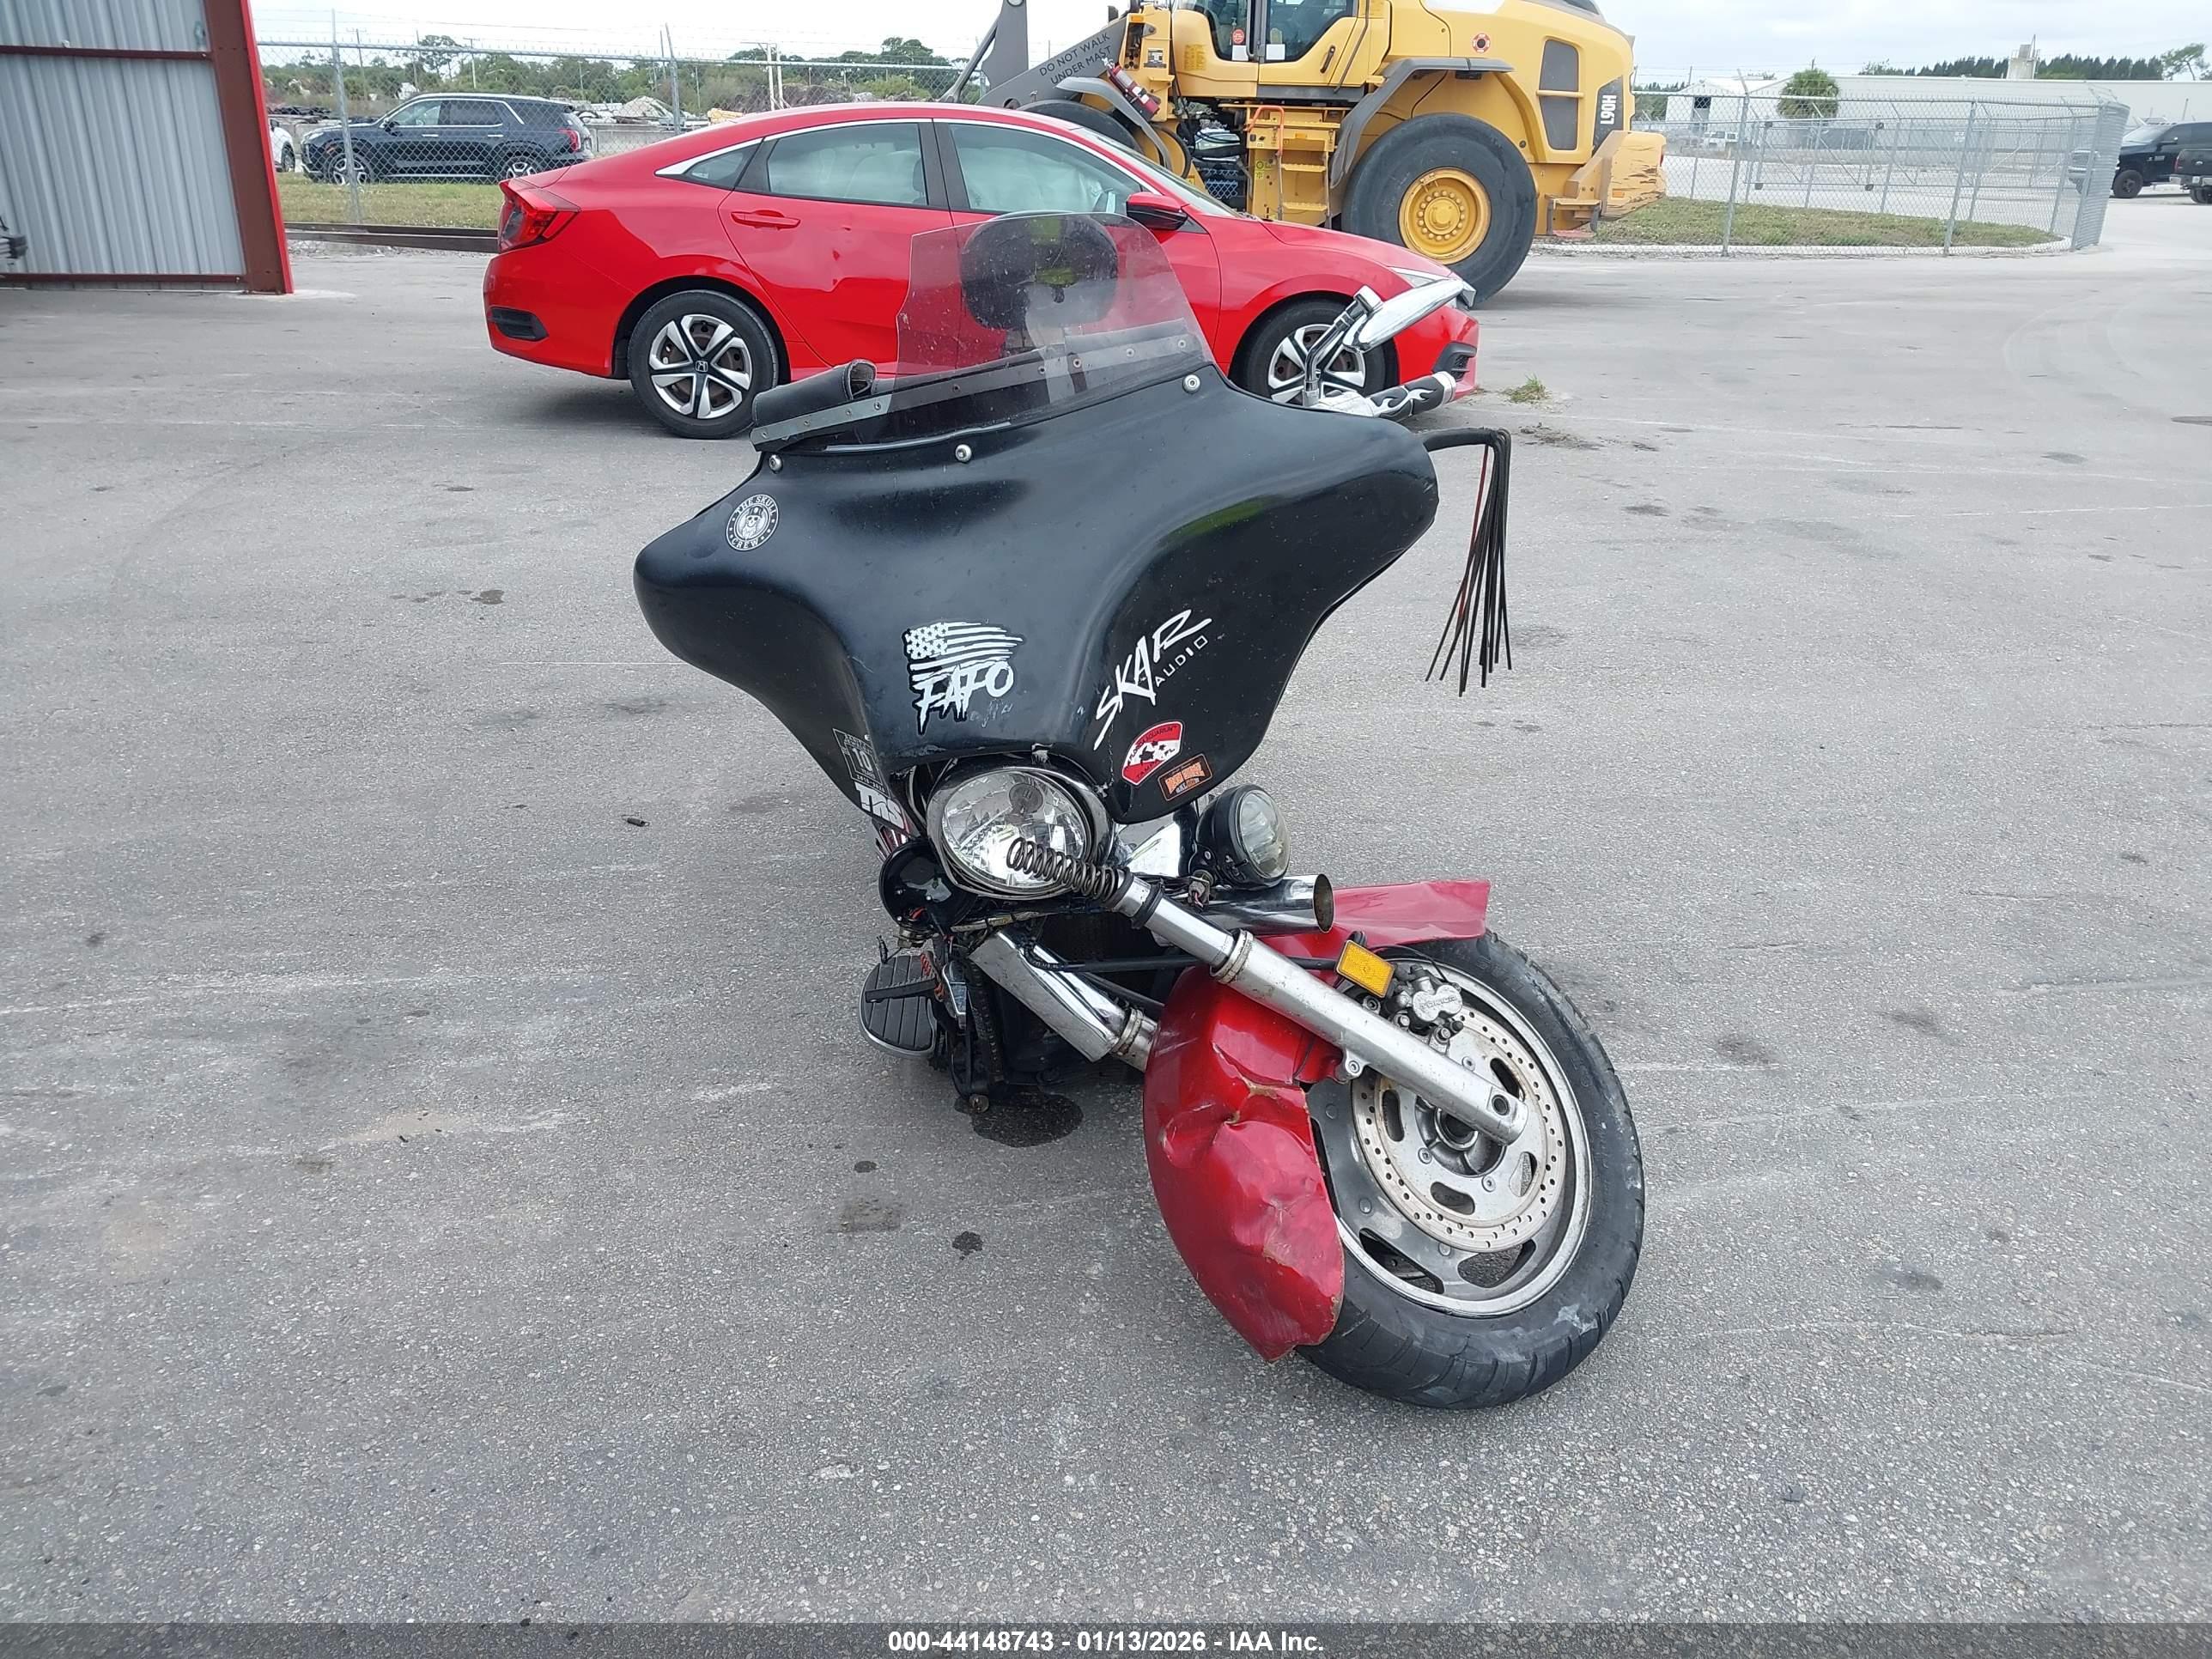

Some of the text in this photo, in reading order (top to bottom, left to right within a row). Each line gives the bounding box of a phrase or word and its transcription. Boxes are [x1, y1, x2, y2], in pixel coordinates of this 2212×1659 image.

[1039, 33, 1110, 76] DO NOT WALK
[1050, 46, 1111, 84] UNDER MAST
[1600, 94, 1617, 125] L90H
[737, 495, 777, 516] THE SKULL
[731, 537, 758, 549] CREW
[1092, 608, 1212, 751] SKAR
[1154, 635, 1209, 688] AUDIO
[912, 659, 1015, 733] FAFO
[851, 747, 874, 772] 10
